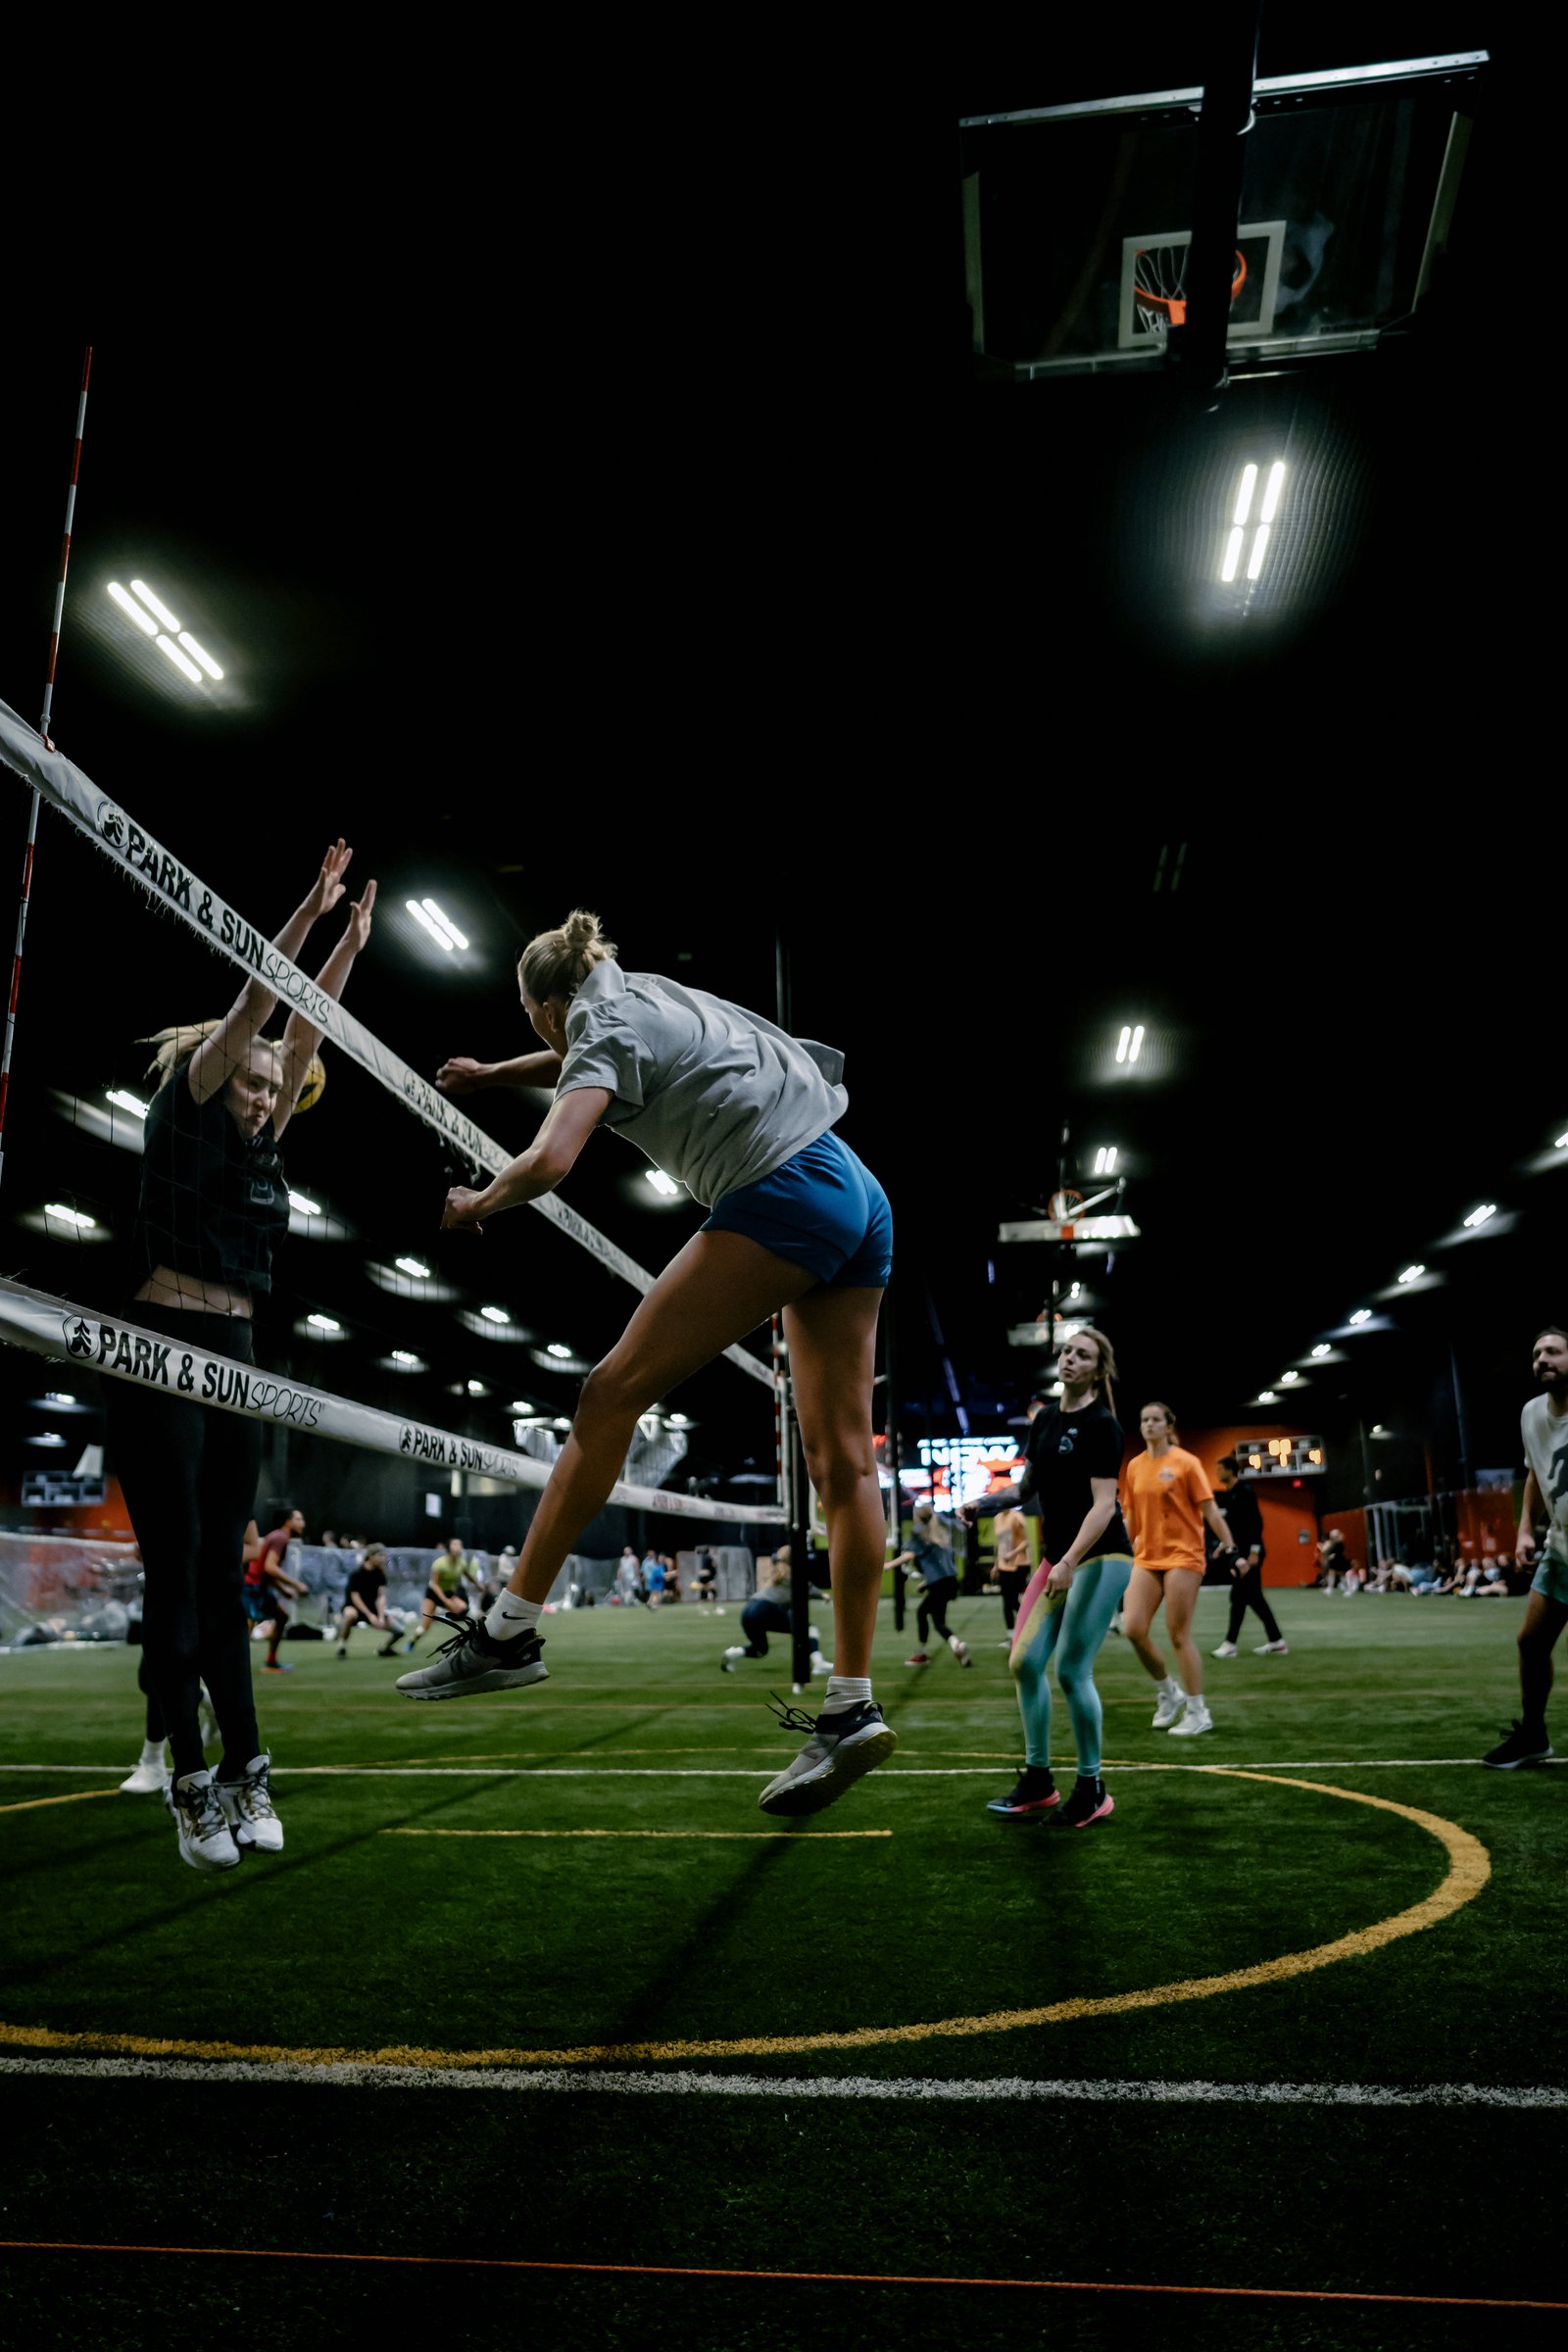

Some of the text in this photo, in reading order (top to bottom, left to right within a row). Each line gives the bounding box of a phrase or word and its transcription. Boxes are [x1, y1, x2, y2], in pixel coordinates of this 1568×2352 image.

[125, 823, 194, 911] PARK
[197, 890, 214, 930] &
[96, 1322, 172, 1386] PARK
[176, 1352, 195, 1393] &
[413, 1427, 446, 1462] PARK
